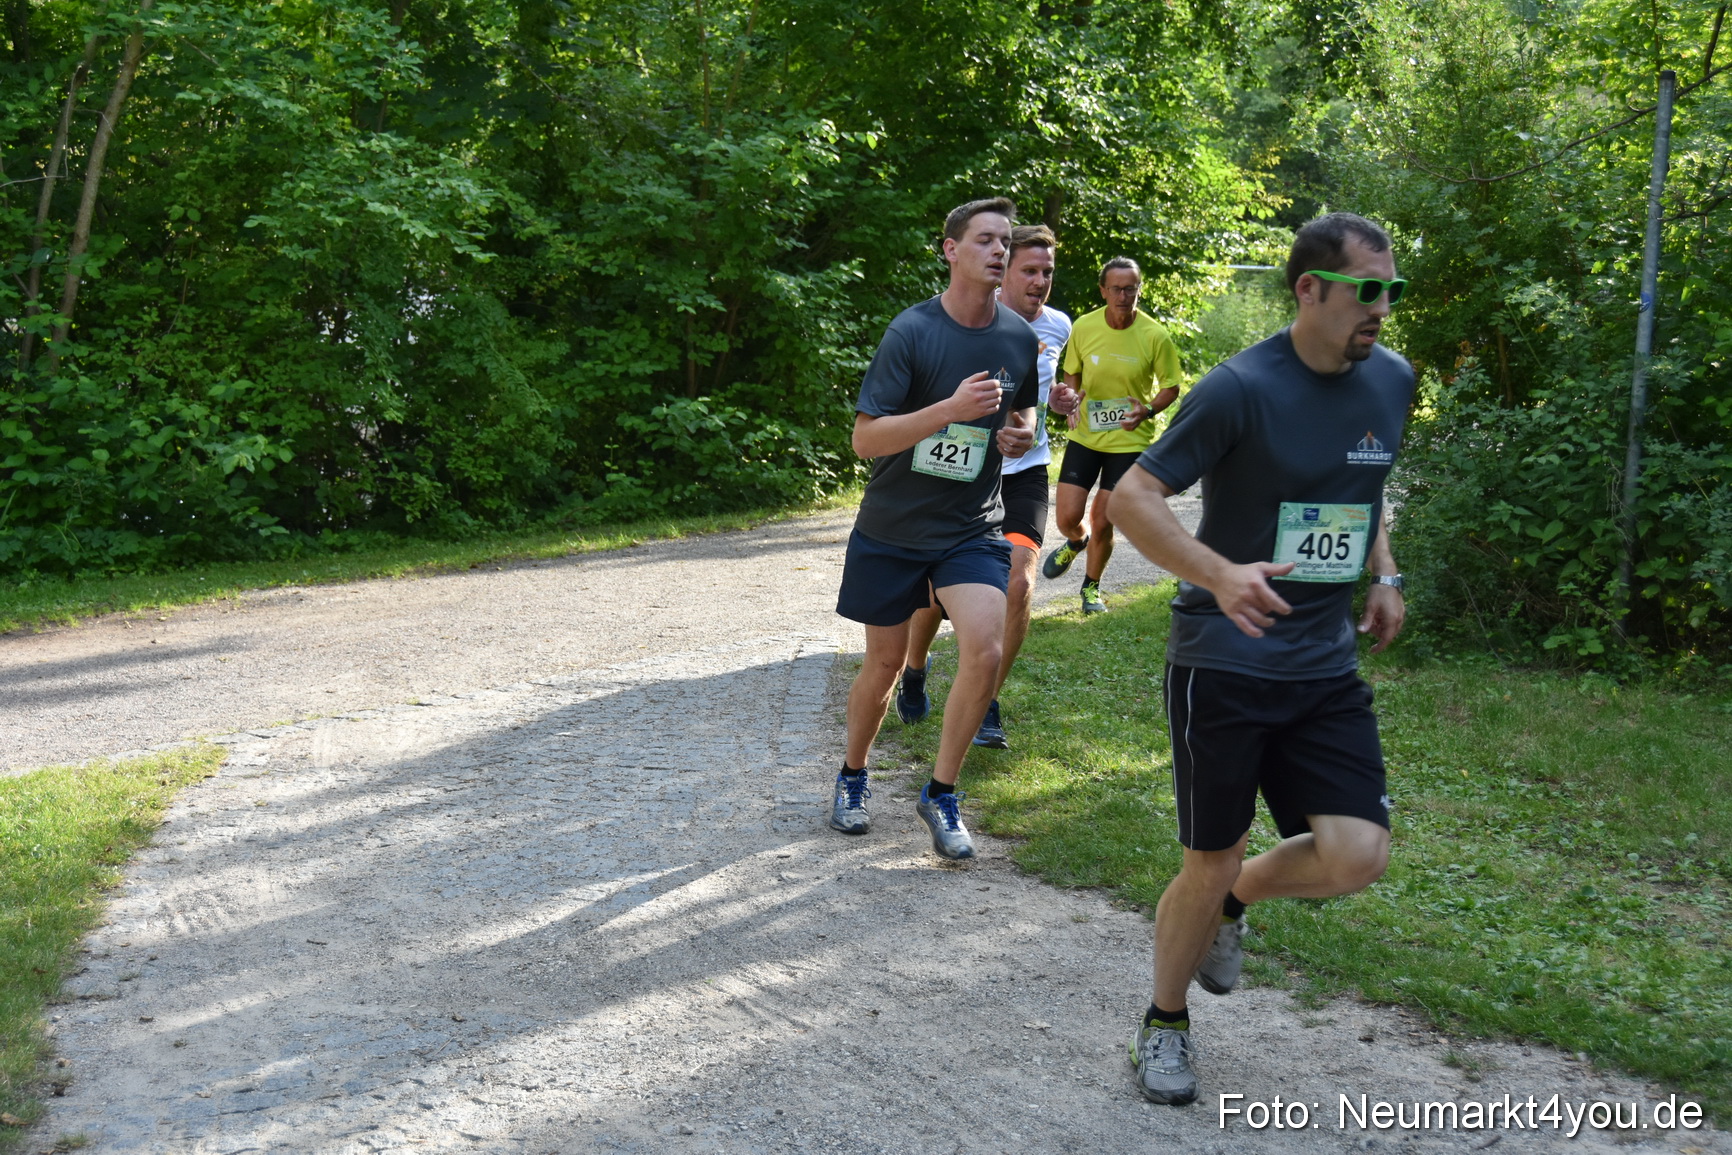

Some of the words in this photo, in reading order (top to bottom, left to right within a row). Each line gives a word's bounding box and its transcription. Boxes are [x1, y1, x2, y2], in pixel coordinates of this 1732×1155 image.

[1092, 409, 1126, 423] 1302
[929, 441, 970, 466] 421
[1346, 451, 1392, 461] BURKHARDT
[925, 460, 947, 469] Lederer
[948, 463, 973, 473] Bernhard
[1297, 532, 1350, 561] 405
[1295, 561, 1324, 571] ollinger
[1326, 561, 1352, 569] Matthias
